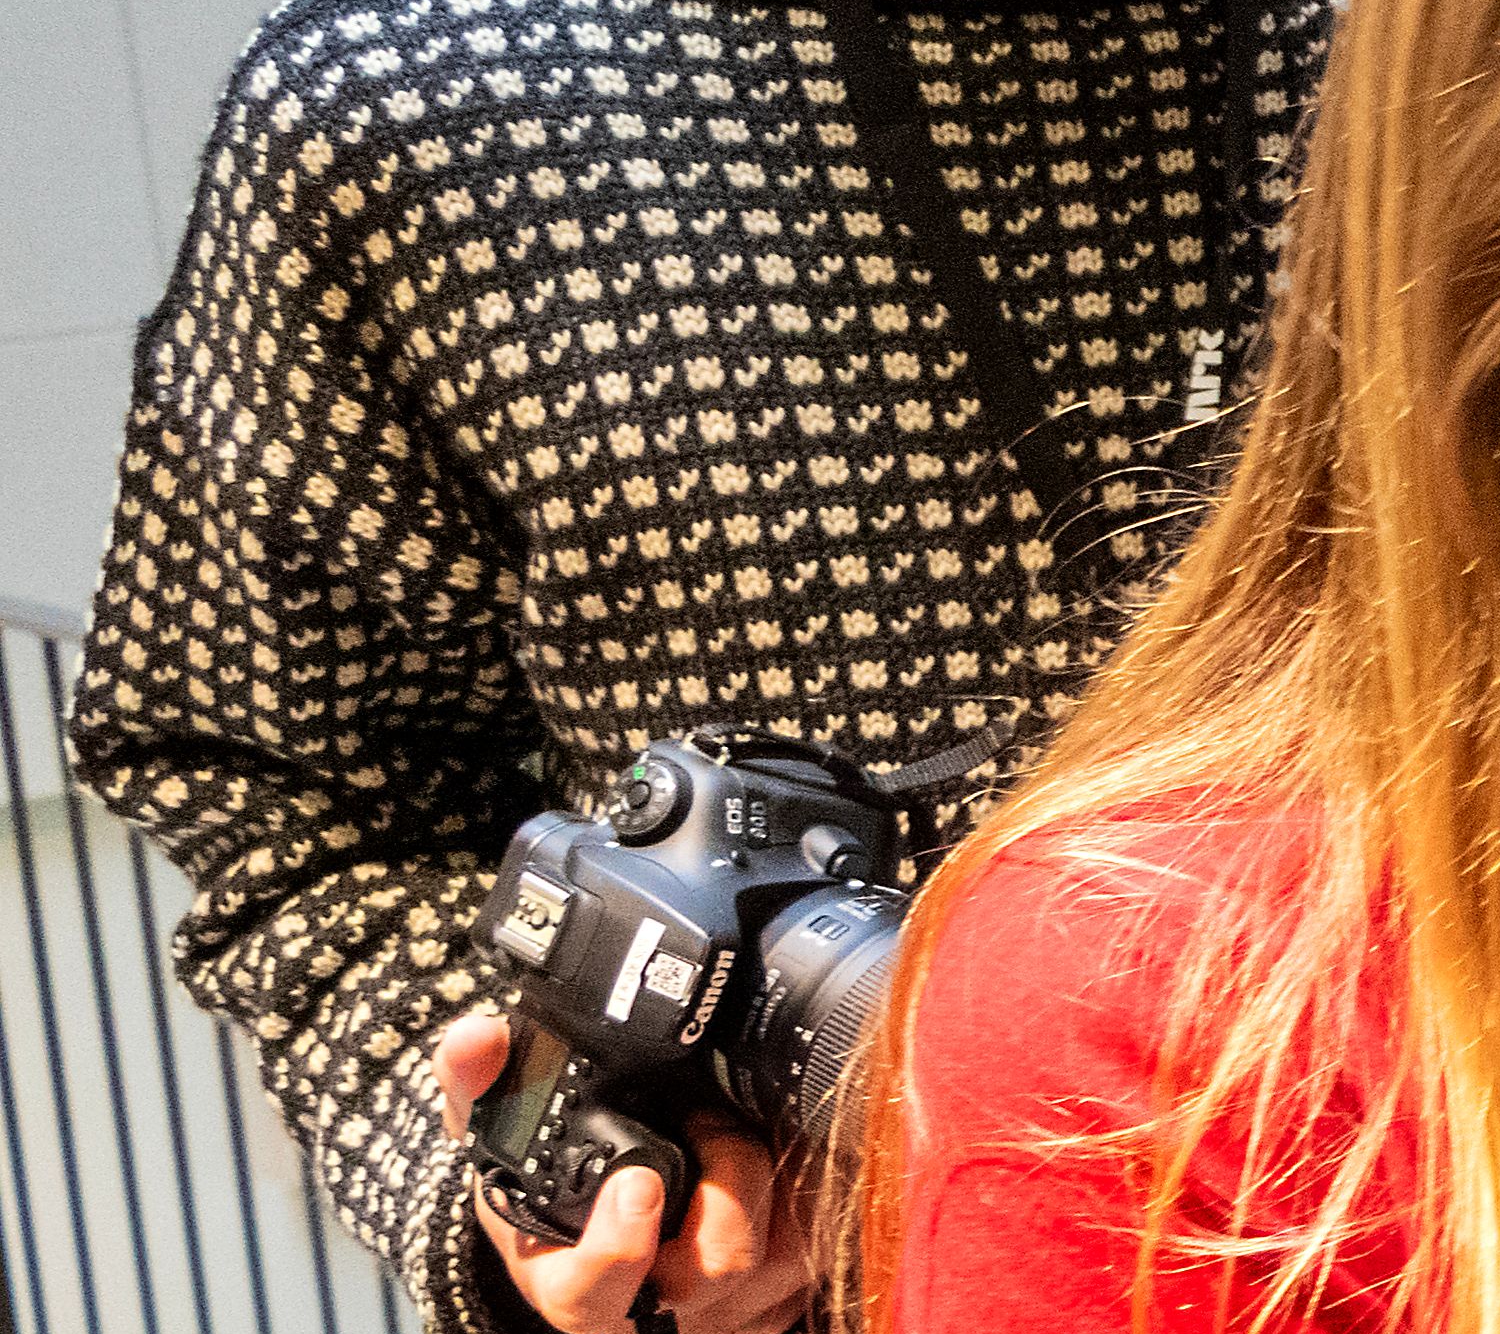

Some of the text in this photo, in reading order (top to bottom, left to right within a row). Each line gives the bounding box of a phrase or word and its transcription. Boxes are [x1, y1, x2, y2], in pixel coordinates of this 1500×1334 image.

[1183, 328, 1224, 423] NRK
[725, 797, 743, 834] EOS
[681, 950, 736, 1045] Canon
